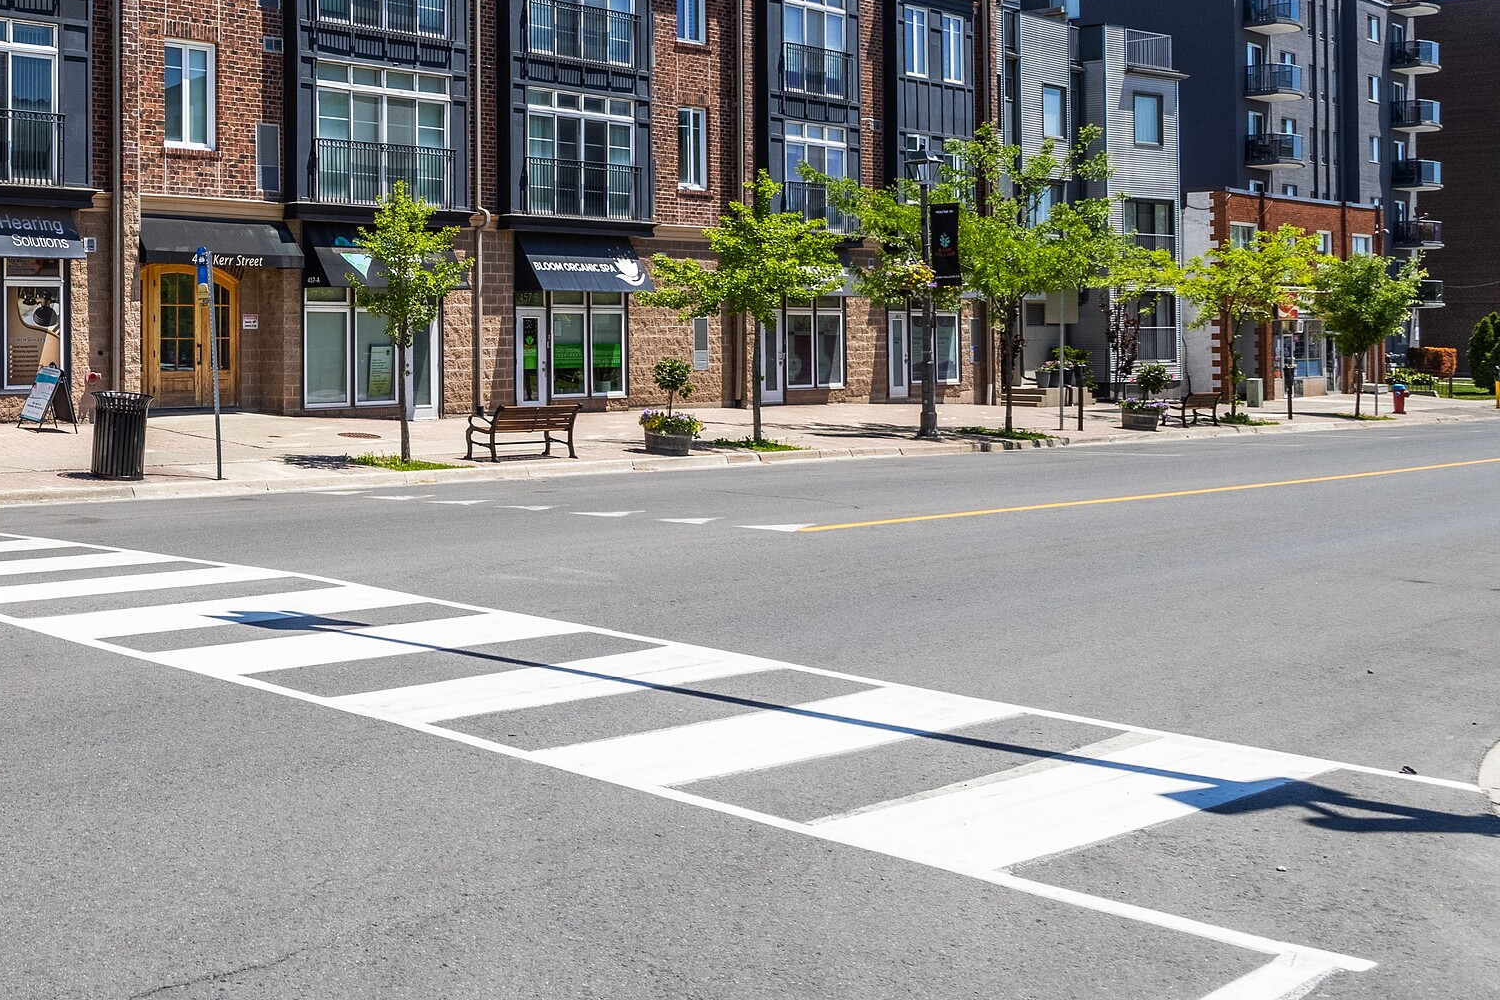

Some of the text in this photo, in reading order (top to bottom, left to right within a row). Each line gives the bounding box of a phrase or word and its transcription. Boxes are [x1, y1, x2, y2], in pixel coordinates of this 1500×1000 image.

[0, 214, 64, 235] Hearing
[11, 233, 70, 249] Solutions
[212, 254, 234, 266] Kerr
[235, 254, 264, 267] Street
[533, 261, 617, 273] BLOOM ORGANIC SPA
[518, 292, 532, 304] 457
